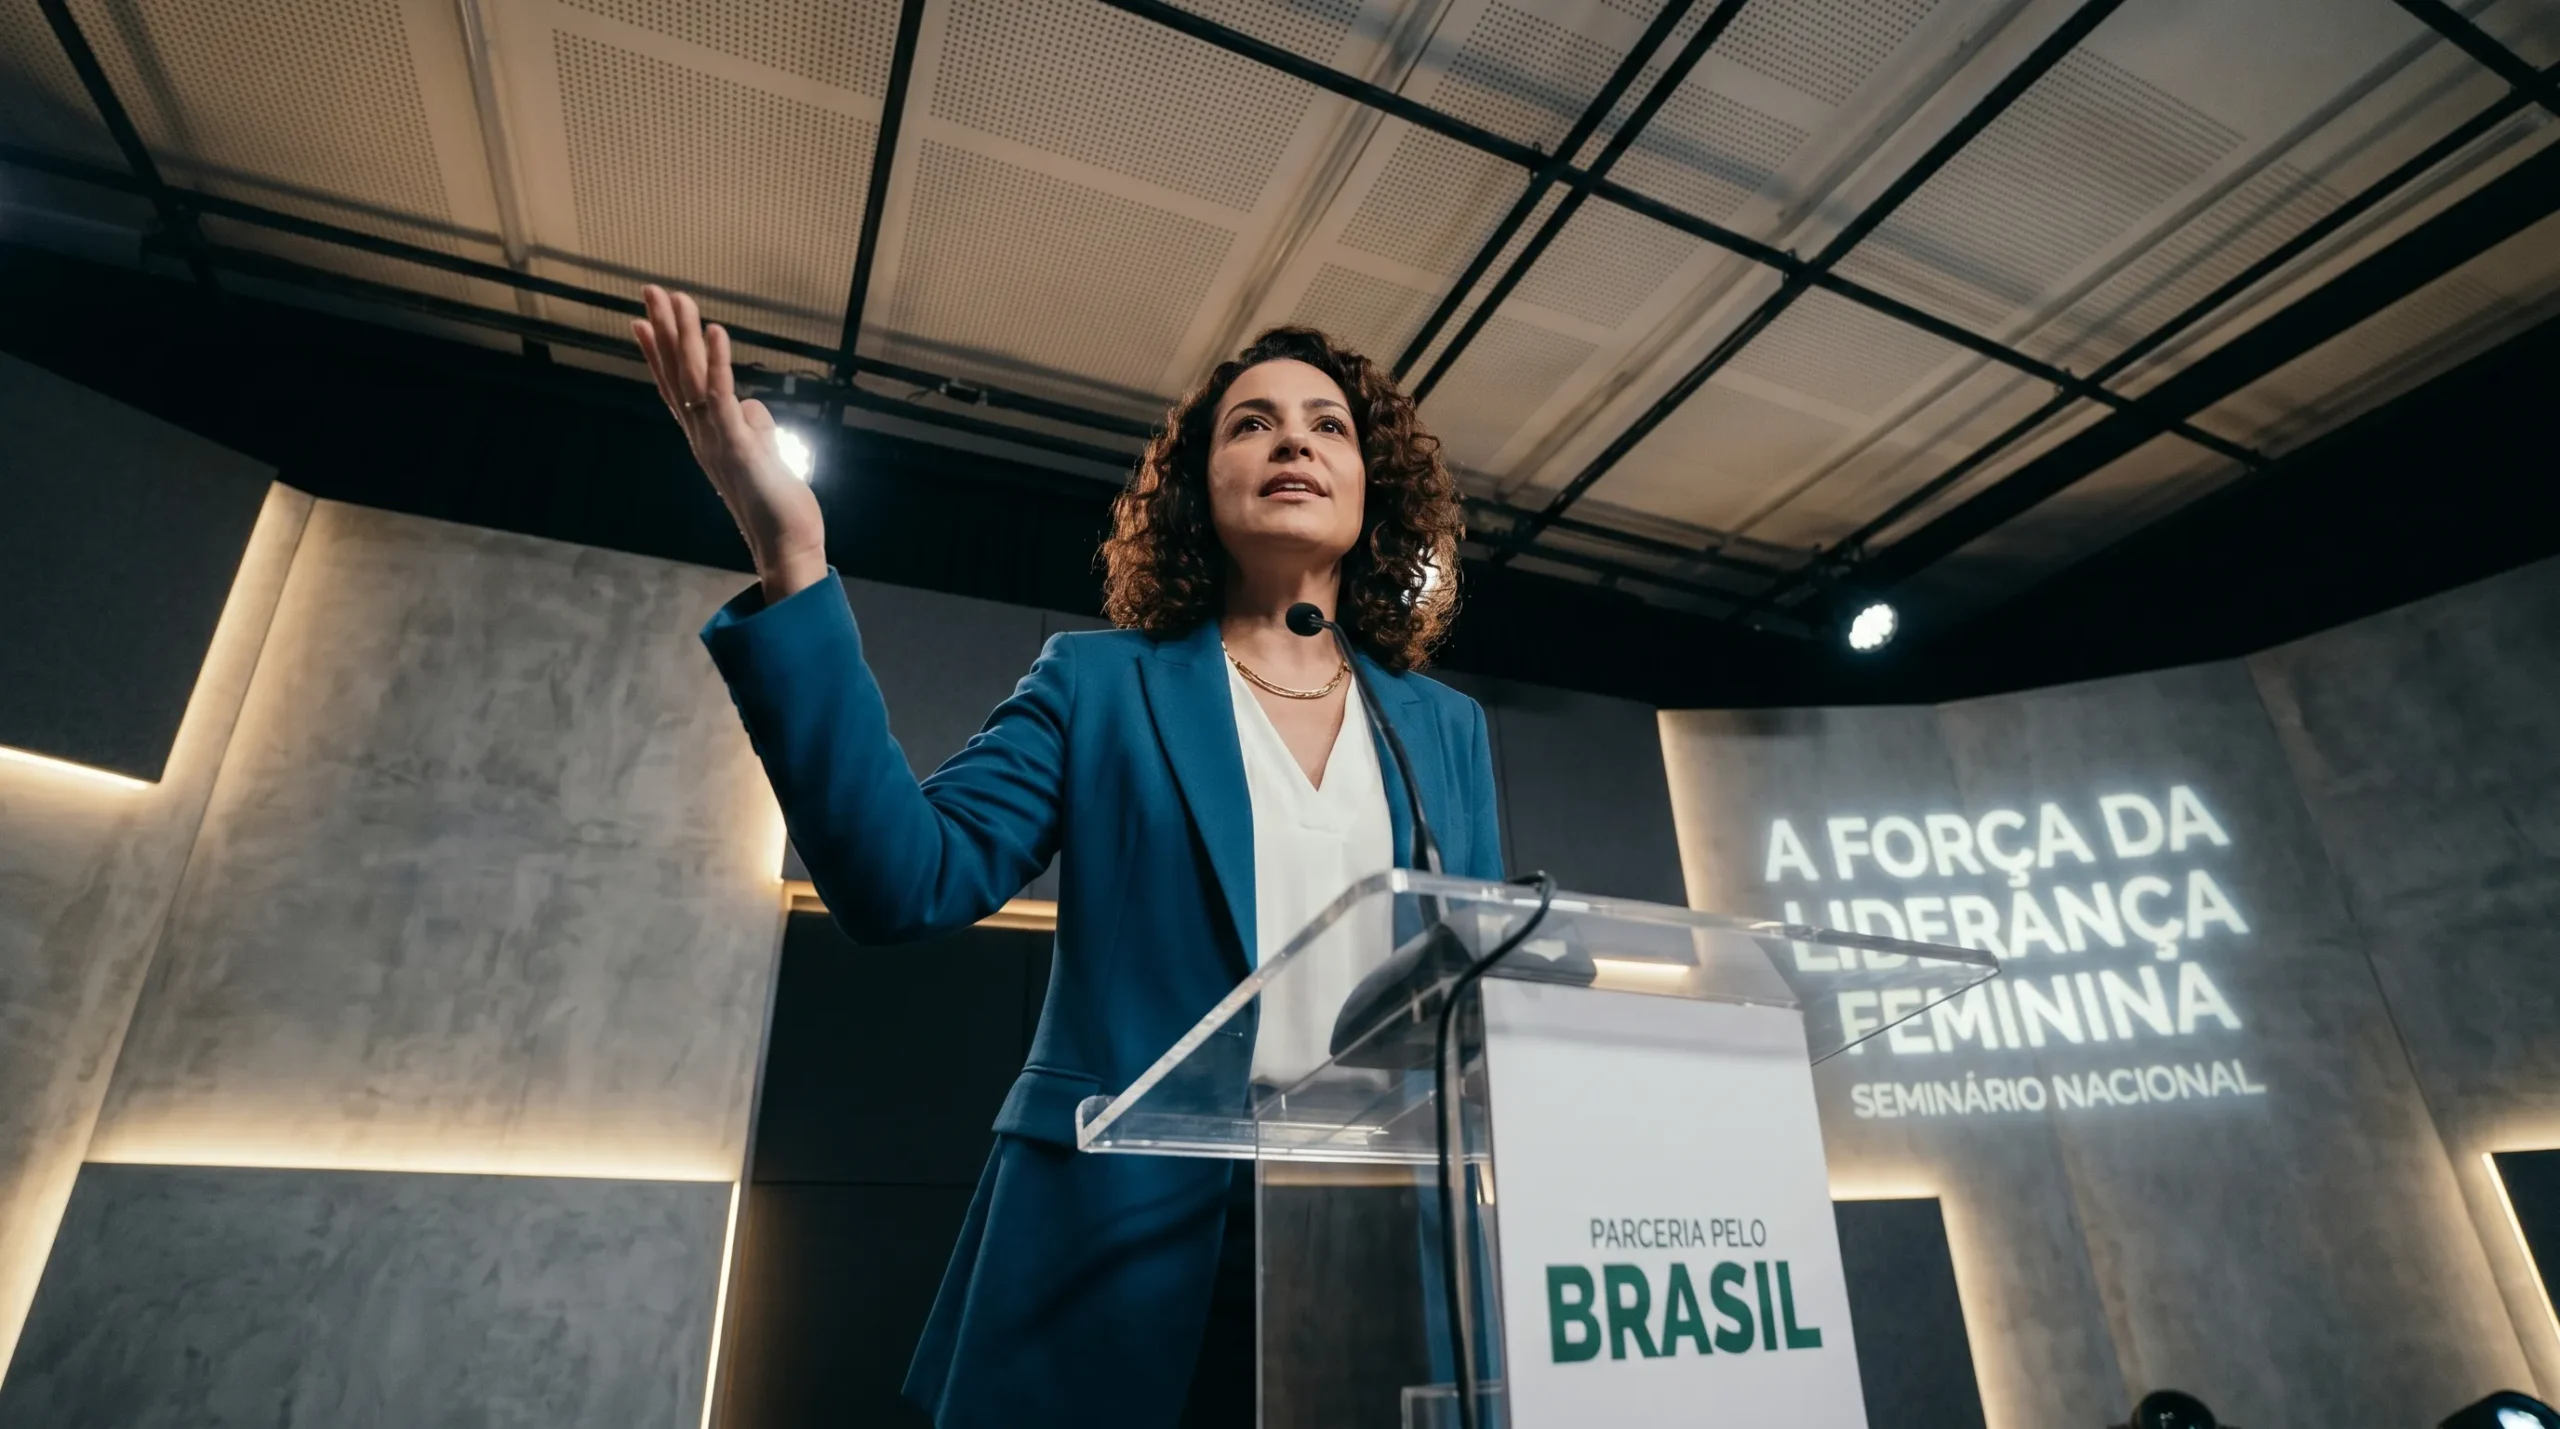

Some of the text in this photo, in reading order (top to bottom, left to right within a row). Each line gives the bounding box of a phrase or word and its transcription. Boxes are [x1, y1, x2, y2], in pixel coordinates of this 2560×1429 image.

[1765, 785, 2230, 886] A FORÇA DA
[1784, 868, 2248, 970] LIDERANÇA
[1837, 961, 2240, 1053] FEMININA
[1851, 1058, 2265, 1116] SEMINÁRIO NACIONAL
[1590, 1218, 1765, 1247] PARCERIA PELO
[1545, 1260, 1822, 1363] BRASIL
